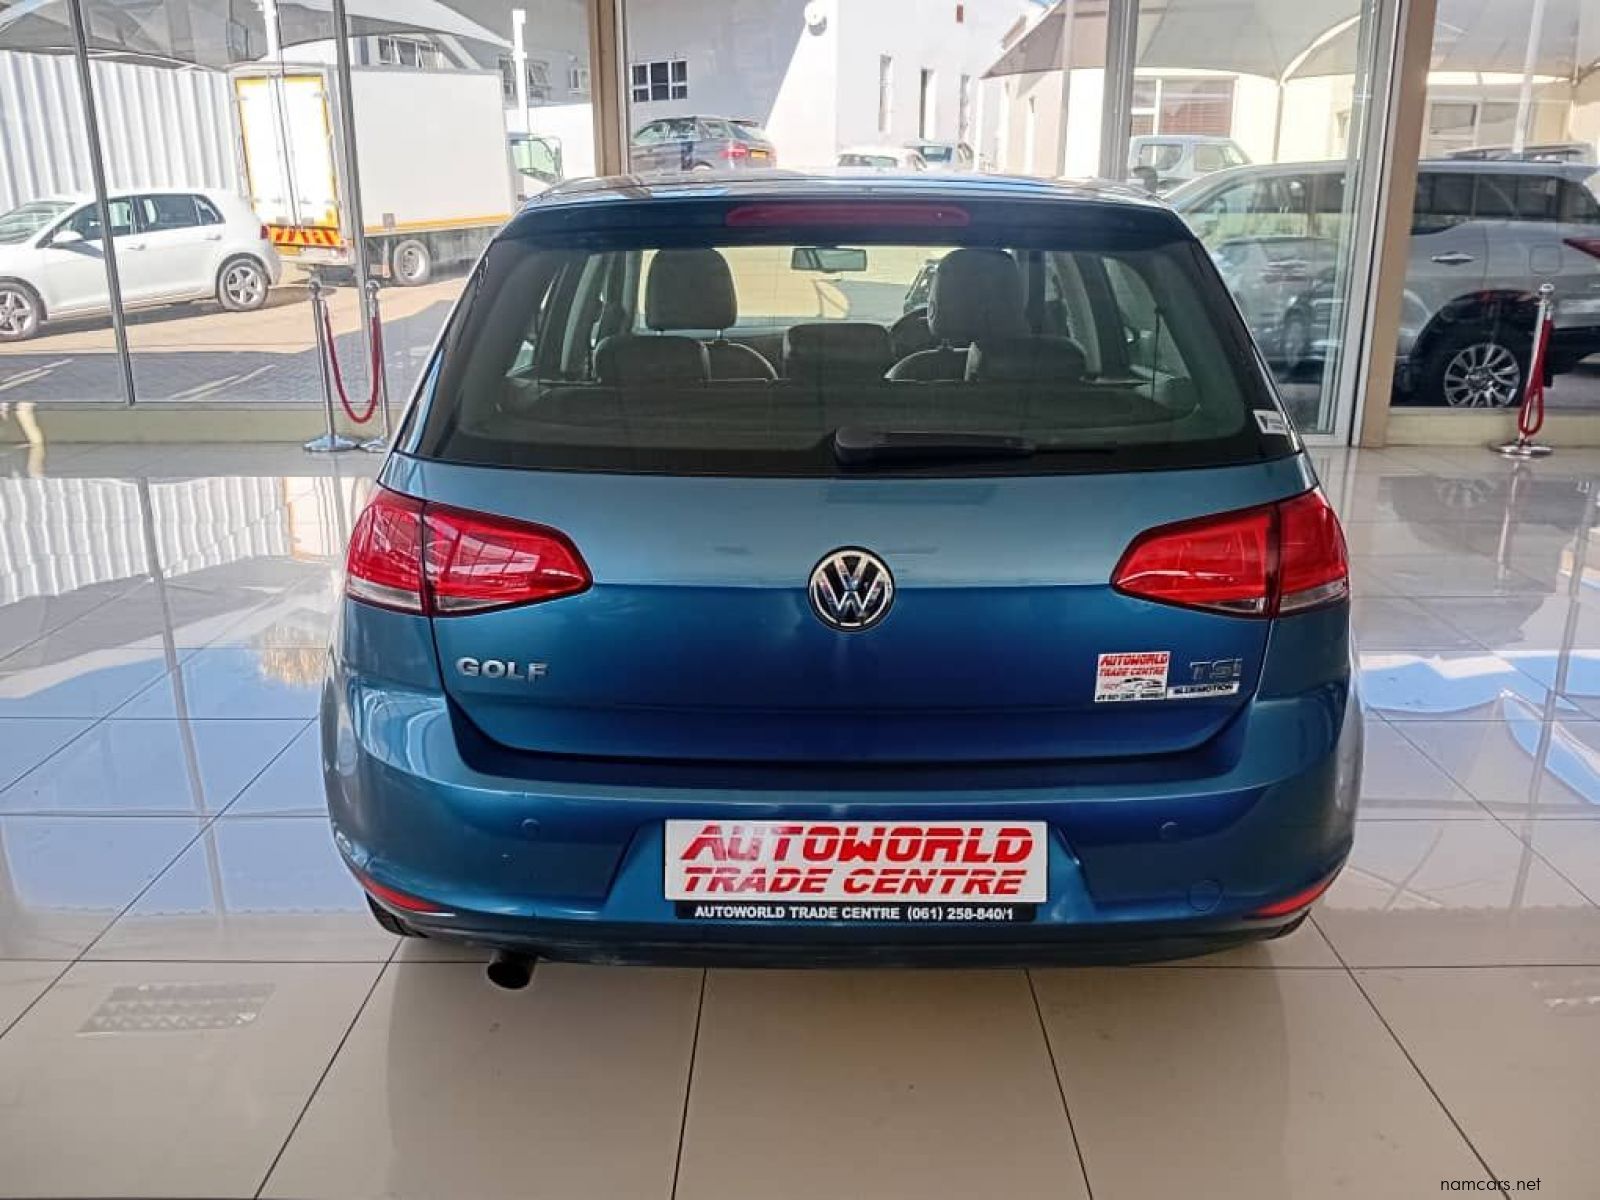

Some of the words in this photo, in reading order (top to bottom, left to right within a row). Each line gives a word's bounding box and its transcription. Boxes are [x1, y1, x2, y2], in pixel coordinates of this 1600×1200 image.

[1100, 653, 1168, 666] AUTOWORLD
[456, 656, 548, 682] GOLF
[1099, 667, 1128, 677] TRADE
[1130, 666, 1166, 676] CENTRE
[1173, 683, 1234, 695] BLUEMOTION
[681, 824, 1034, 863] AUTOWORLD
[684, 867, 834, 893] TRADE
[843, 868, 1028, 895] CENTRE
[694, 905, 786, 919] AUTOWORLD
[789, 906, 838, 919] TRADE
[841, 906, 901, 920] CENTRE
[907, 907, 943, 922] (061)
